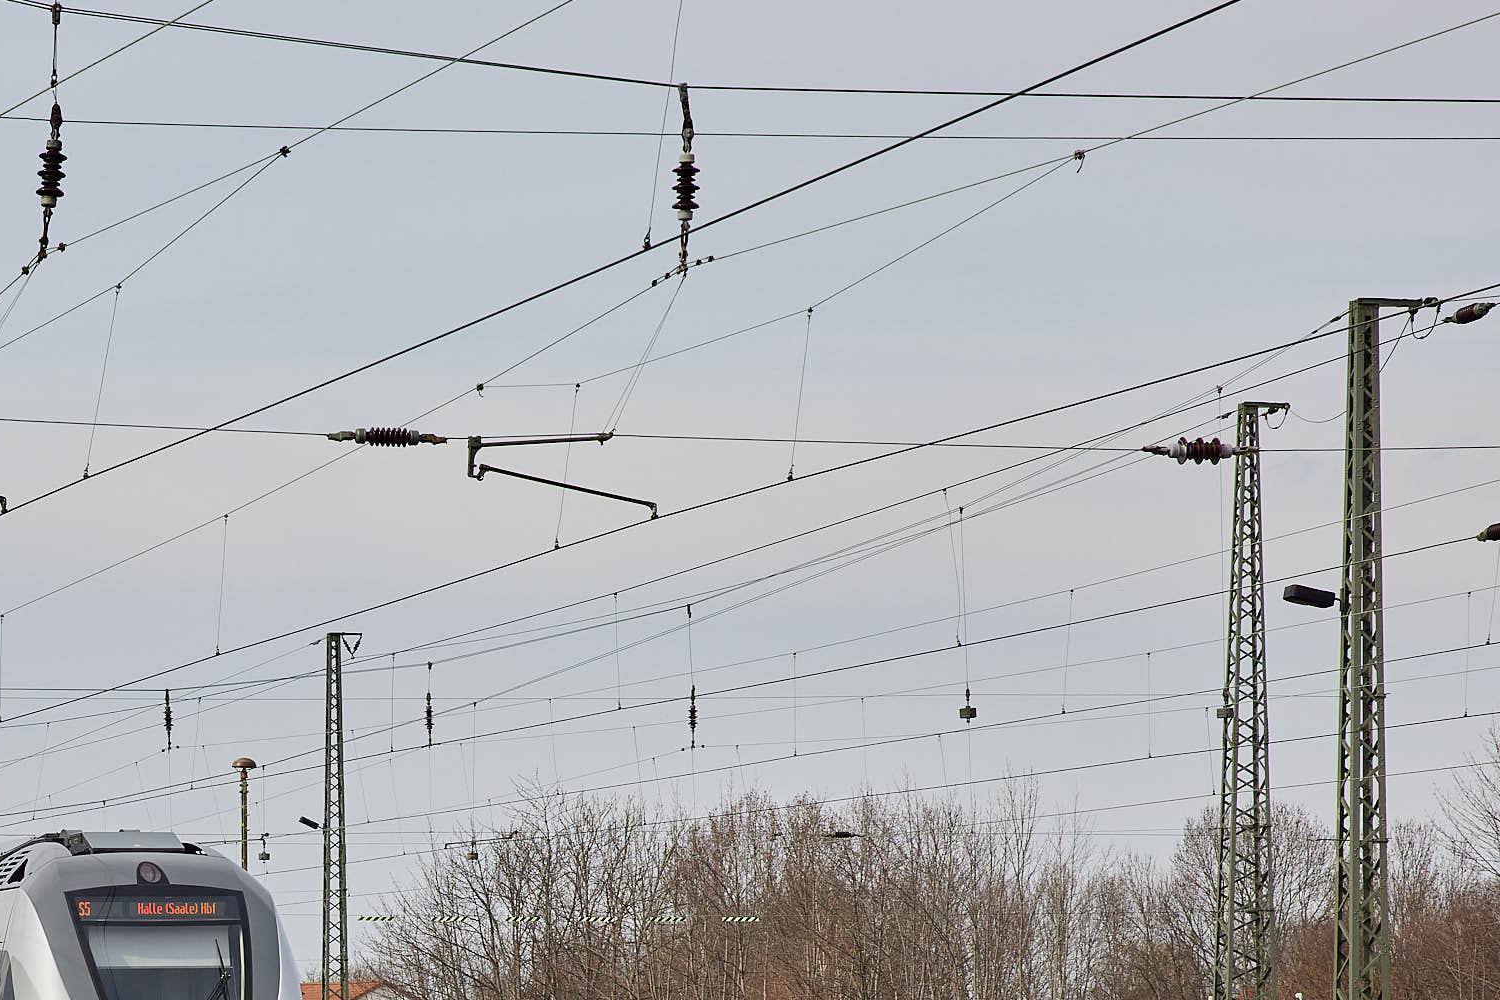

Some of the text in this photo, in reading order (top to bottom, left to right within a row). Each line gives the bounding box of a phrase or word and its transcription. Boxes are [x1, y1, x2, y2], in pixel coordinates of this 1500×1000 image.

[78, 901, 91, 917] S5
[137, 902, 216, 915] Halle (Saale) Hbf
